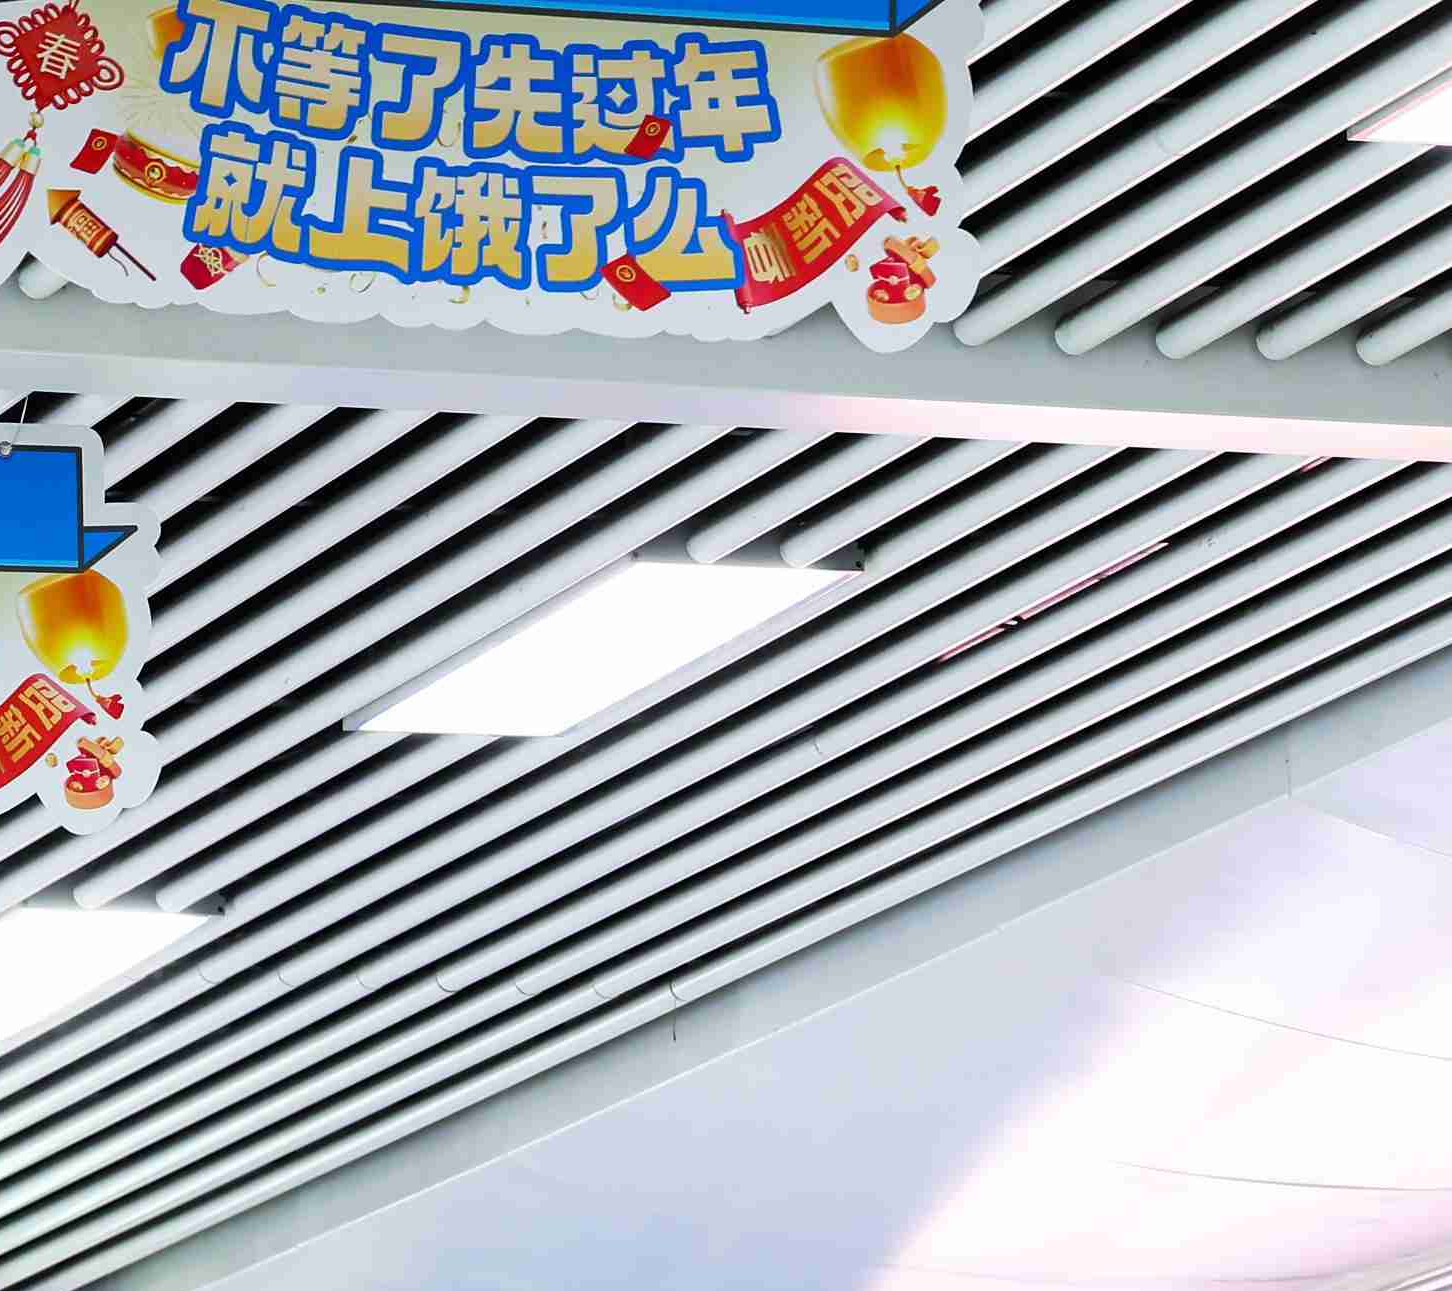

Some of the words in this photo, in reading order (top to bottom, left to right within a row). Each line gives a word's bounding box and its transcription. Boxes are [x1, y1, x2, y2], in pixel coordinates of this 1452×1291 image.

[38, 33, 80, 81] 春
[164, 0, 779, 161] 不等了先过年
[186, 122, 744, 290] 就上饿了么
